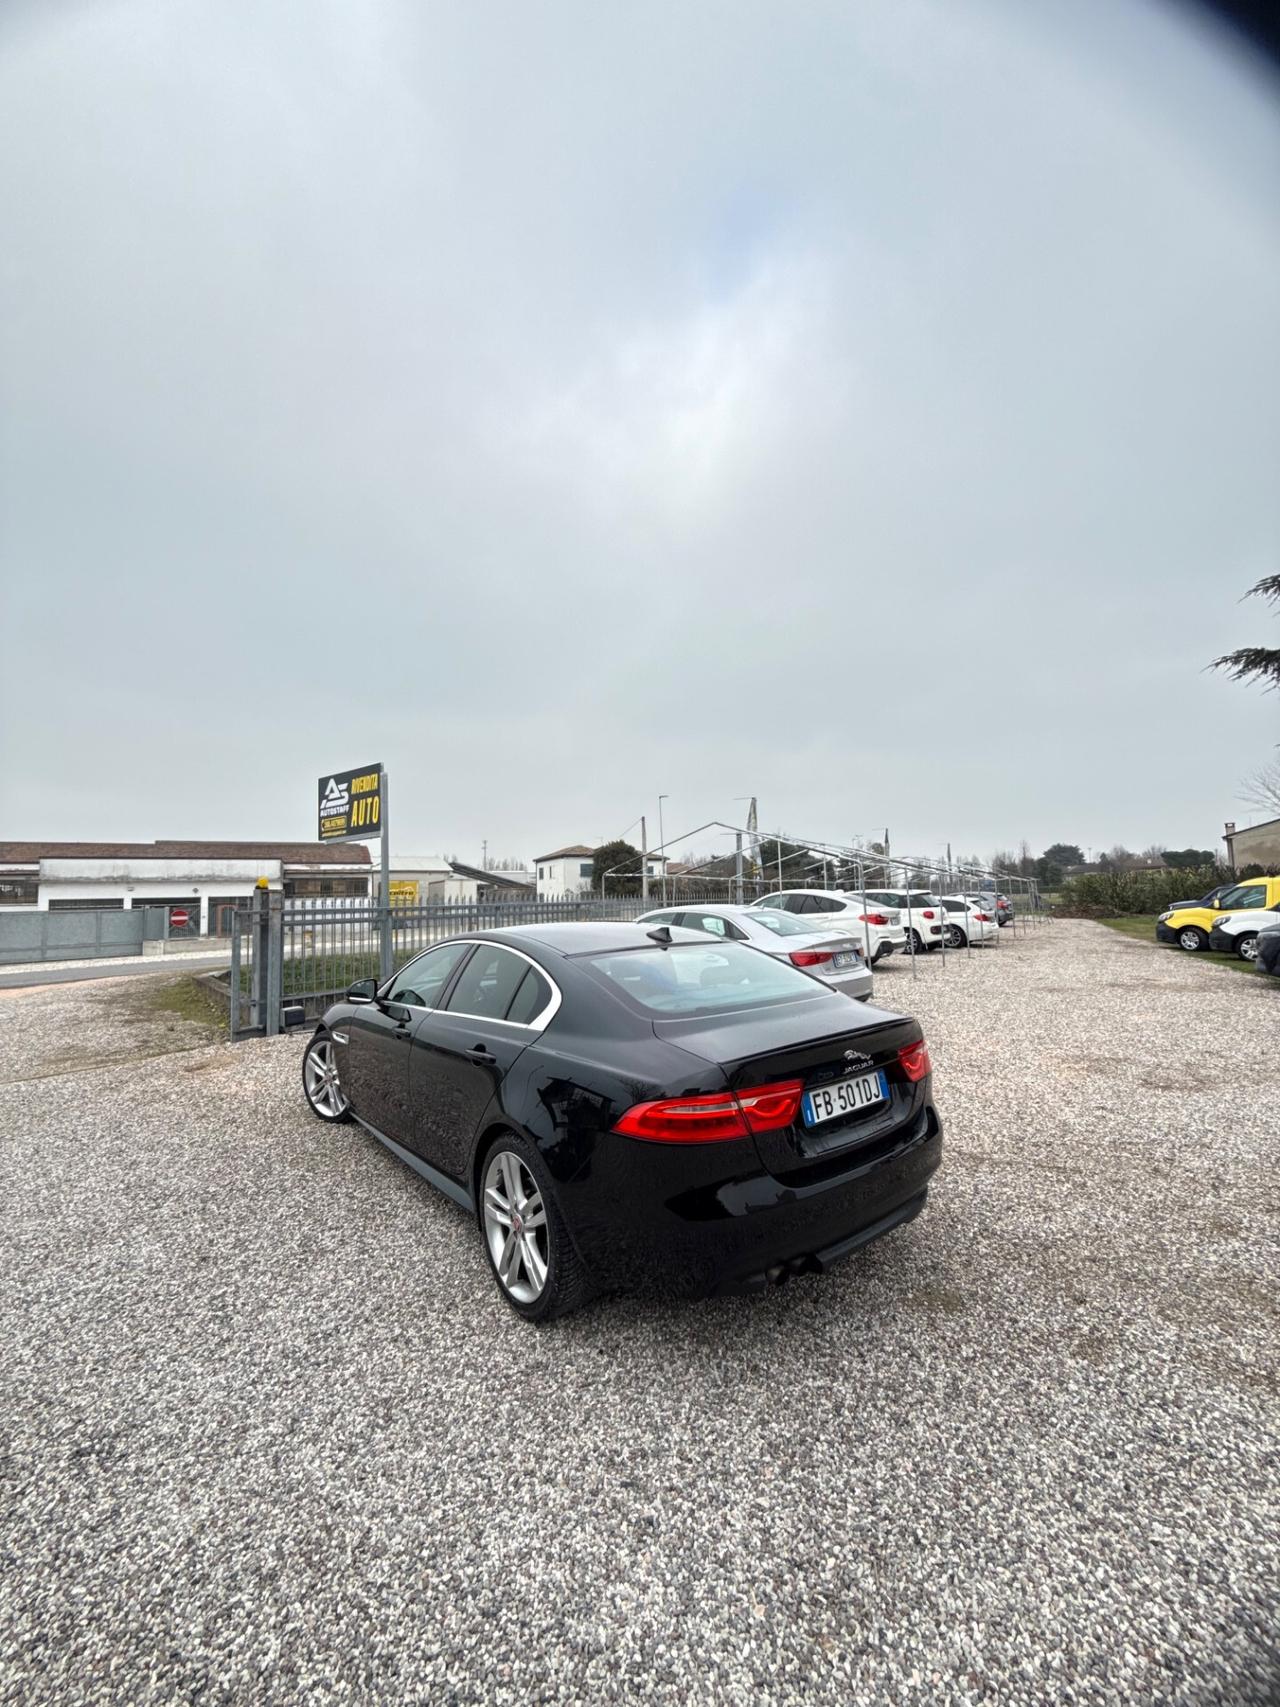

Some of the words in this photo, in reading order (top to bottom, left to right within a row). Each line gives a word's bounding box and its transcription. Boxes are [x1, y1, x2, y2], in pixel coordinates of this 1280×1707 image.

[351, 773, 378, 794] RIVENDITA
[320, 804, 349, 817] AUTOSTAFF
[351, 796, 379, 827] AUTO
[843, 1061, 874, 1074] JAGUAR
[812, 1091, 834, 1120] FB
[837, 1074, 881, 1110] 501DJ
